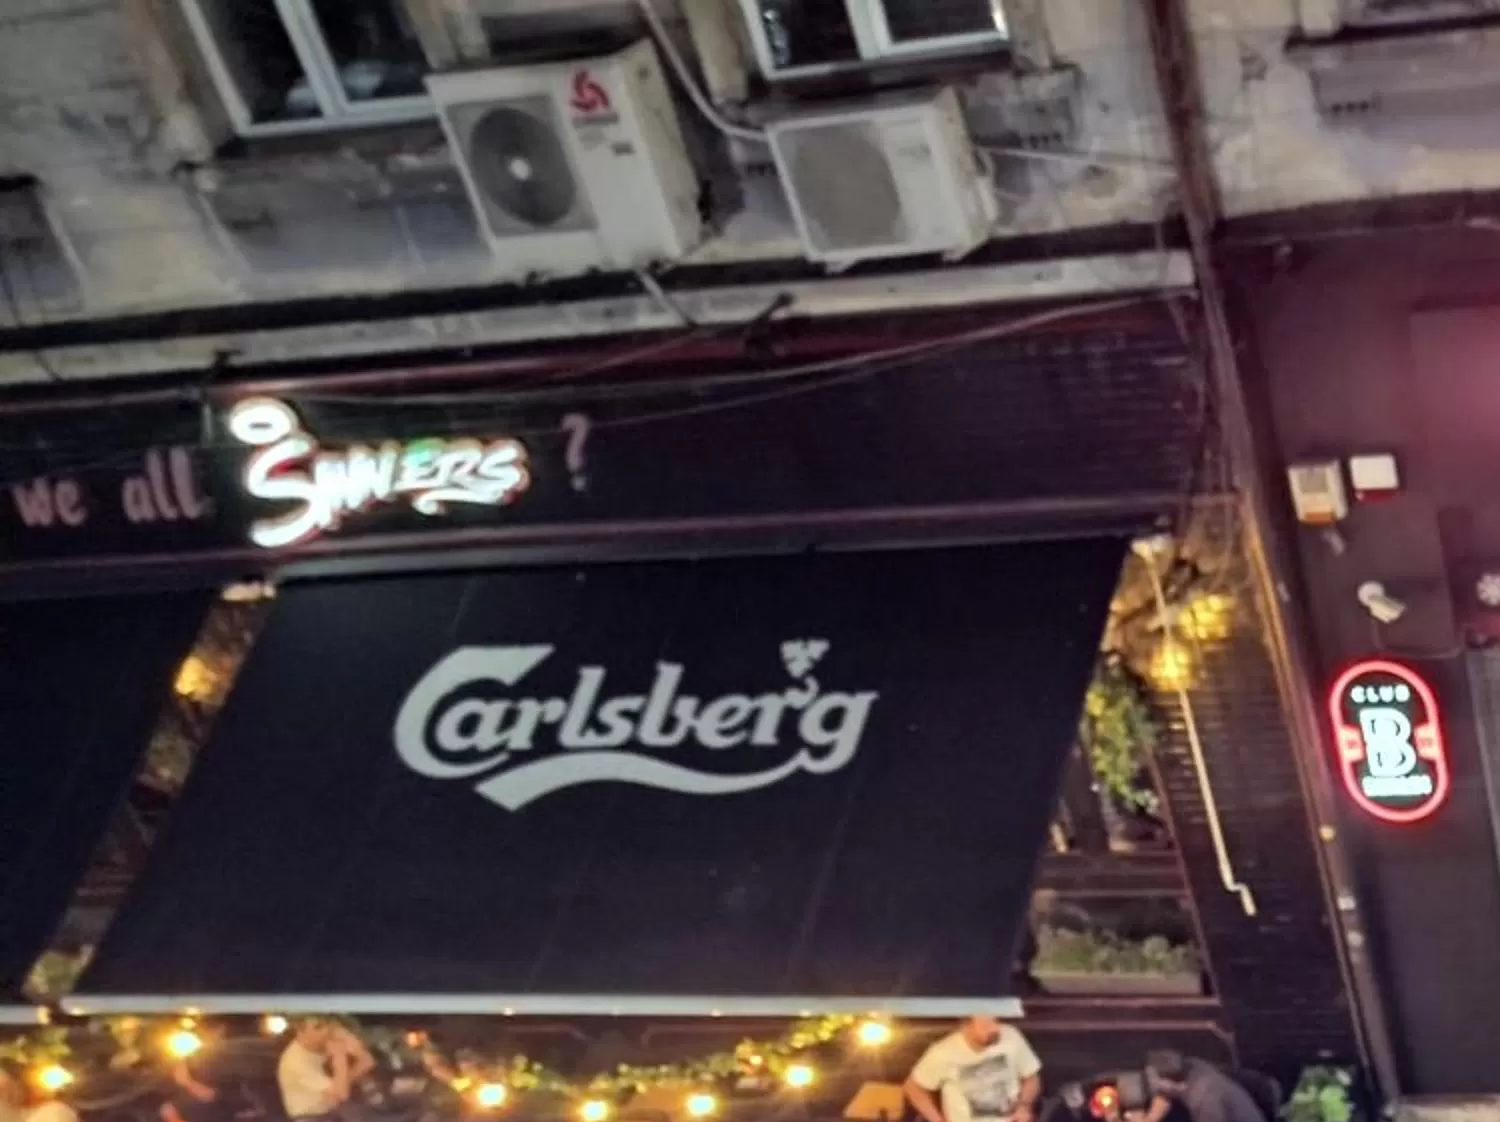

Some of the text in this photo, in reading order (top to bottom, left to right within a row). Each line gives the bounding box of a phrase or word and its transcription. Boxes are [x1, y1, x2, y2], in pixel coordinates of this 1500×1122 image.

[12, 475, 87, 527] we
[122, 446, 204, 522] all
[393, 644, 879, 780] Carlsberg
[1359, 707, 1417, 777] B
